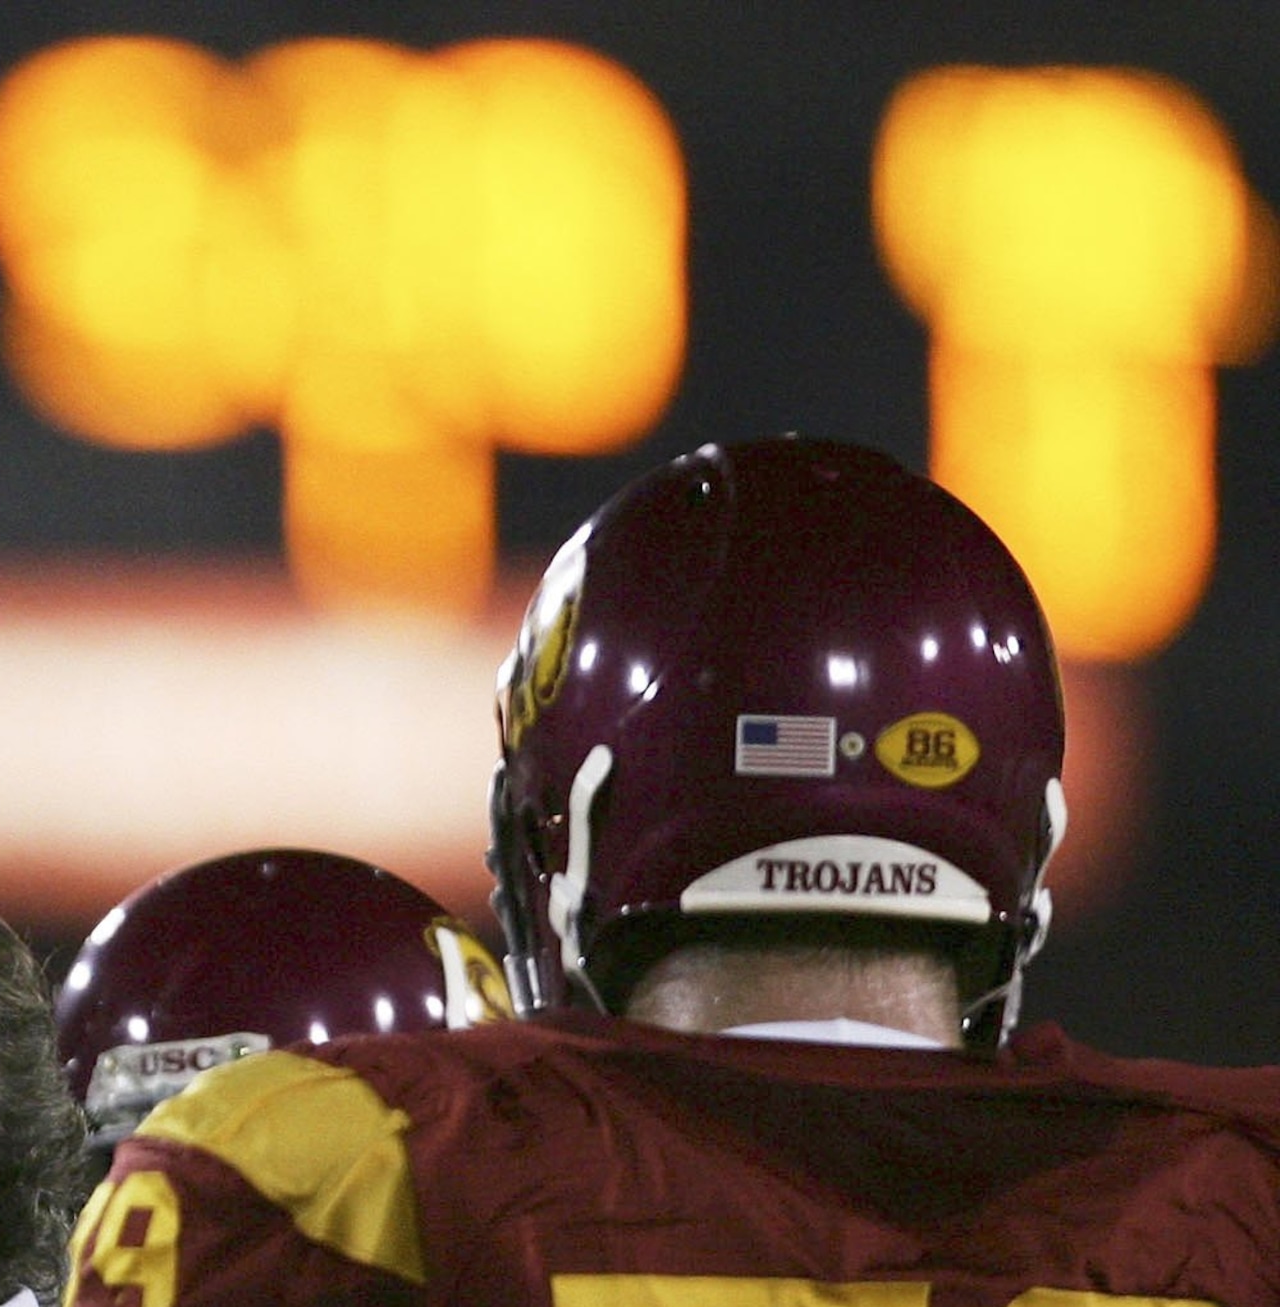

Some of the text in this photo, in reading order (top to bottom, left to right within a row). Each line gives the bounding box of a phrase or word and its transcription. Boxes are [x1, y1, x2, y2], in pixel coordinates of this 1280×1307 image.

[906, 729, 956, 758] 86
[757, 859, 938, 894] TROJANS
[141, 1046, 216, 1076] USC
